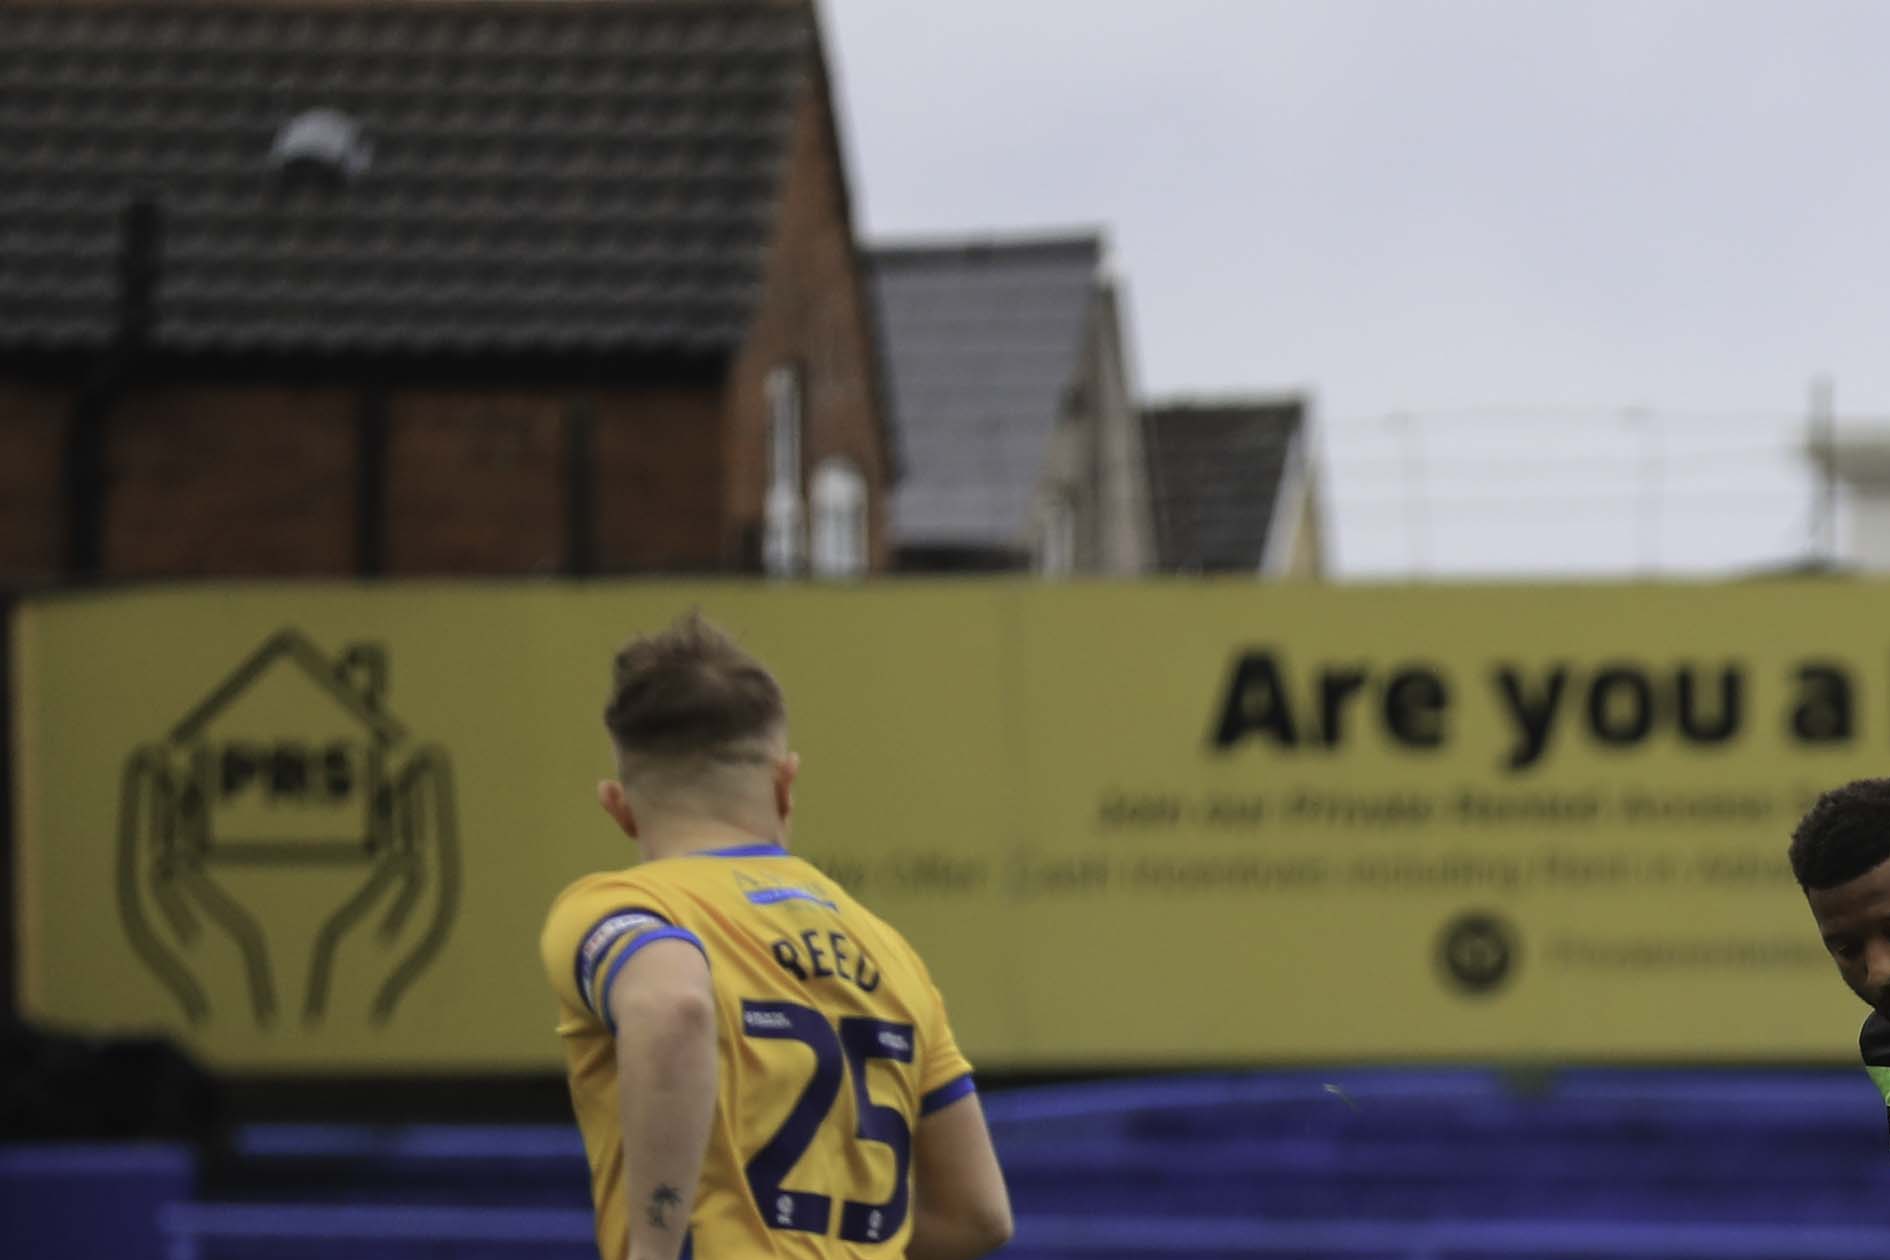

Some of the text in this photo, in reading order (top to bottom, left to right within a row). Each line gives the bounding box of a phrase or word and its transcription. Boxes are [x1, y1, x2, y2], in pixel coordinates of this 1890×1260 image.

[1207, 642, 1452, 752] Are
[1486, 655, 1744, 772] you
[1783, 660, 1858, 748] a
[772, 929, 880, 993] REED
[741, 997, 915, 1245] 25
